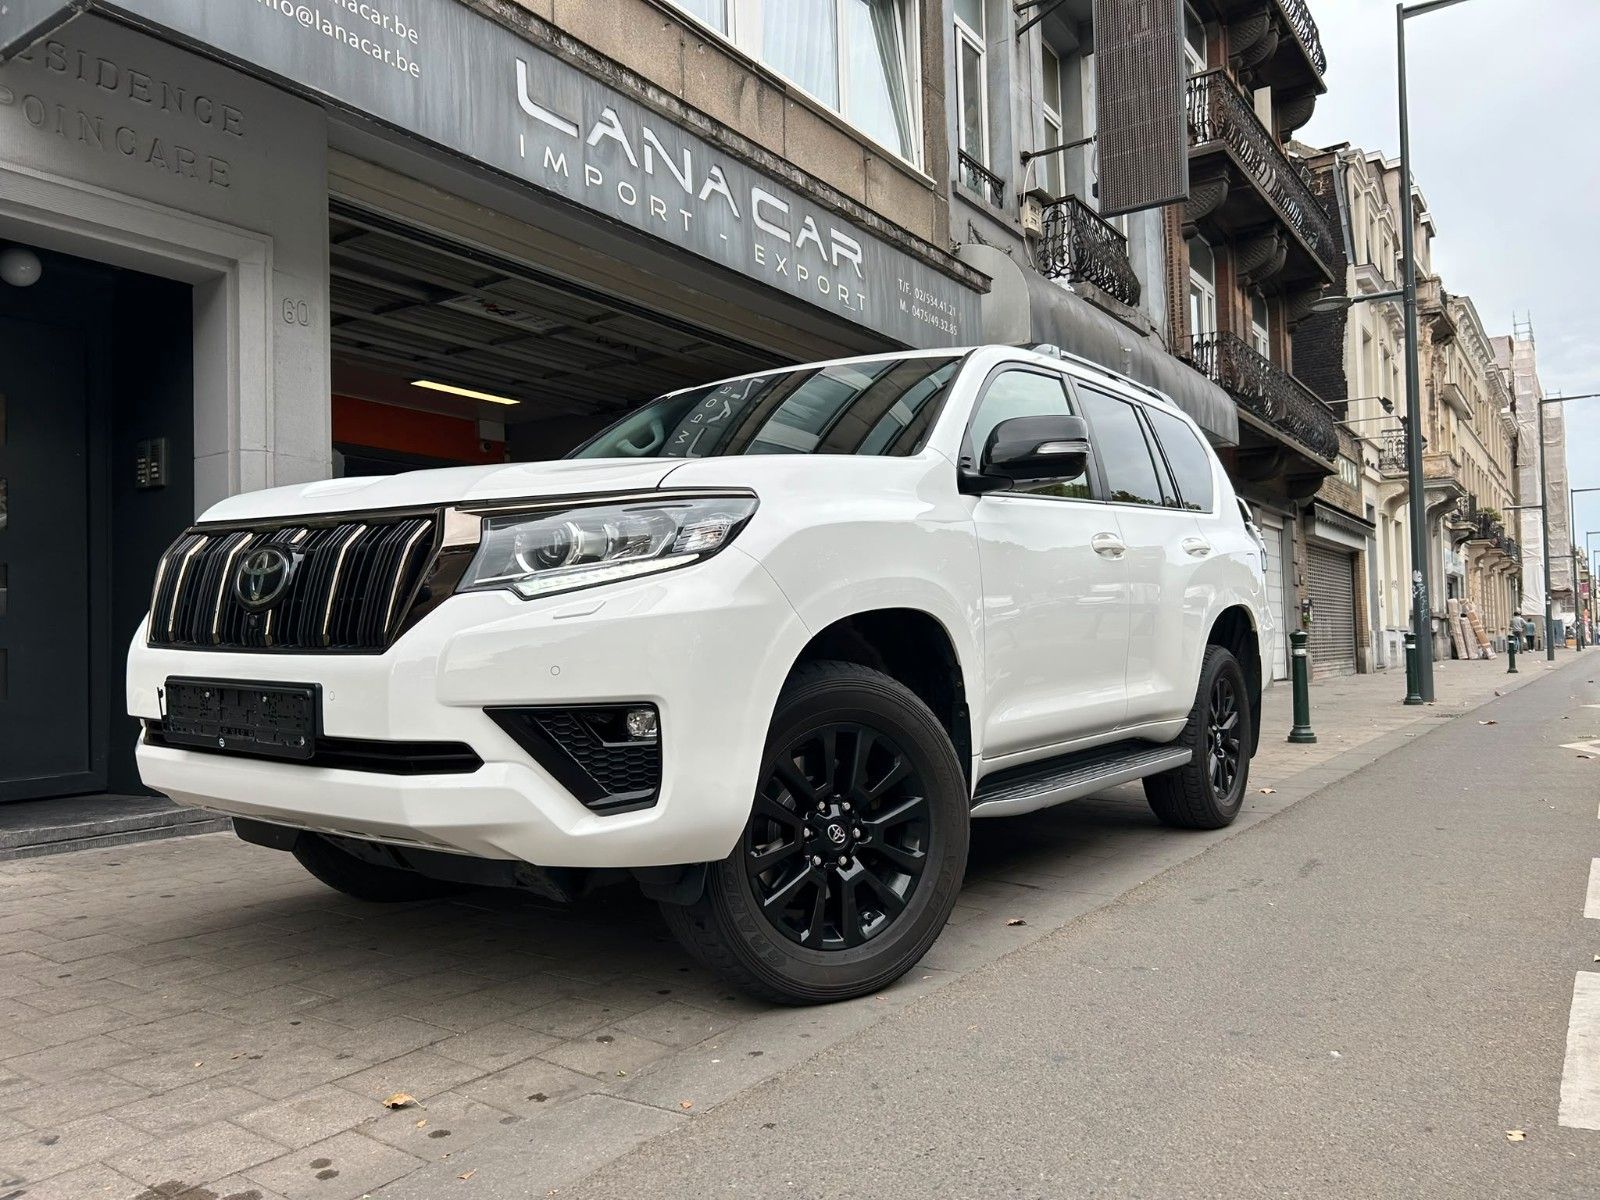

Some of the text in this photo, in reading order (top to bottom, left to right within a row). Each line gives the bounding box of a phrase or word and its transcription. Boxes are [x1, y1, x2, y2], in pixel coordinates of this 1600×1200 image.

[256, 0, 420, 78] o@lanacar.be
[18, 40, 244, 137] SIDENCE
[516, 57, 864, 280] LANACAR
[519, 133, 693, 232] IMPORT
[754, 243, 866, 311] EXPORT
[282, 297, 309, 327] 60
